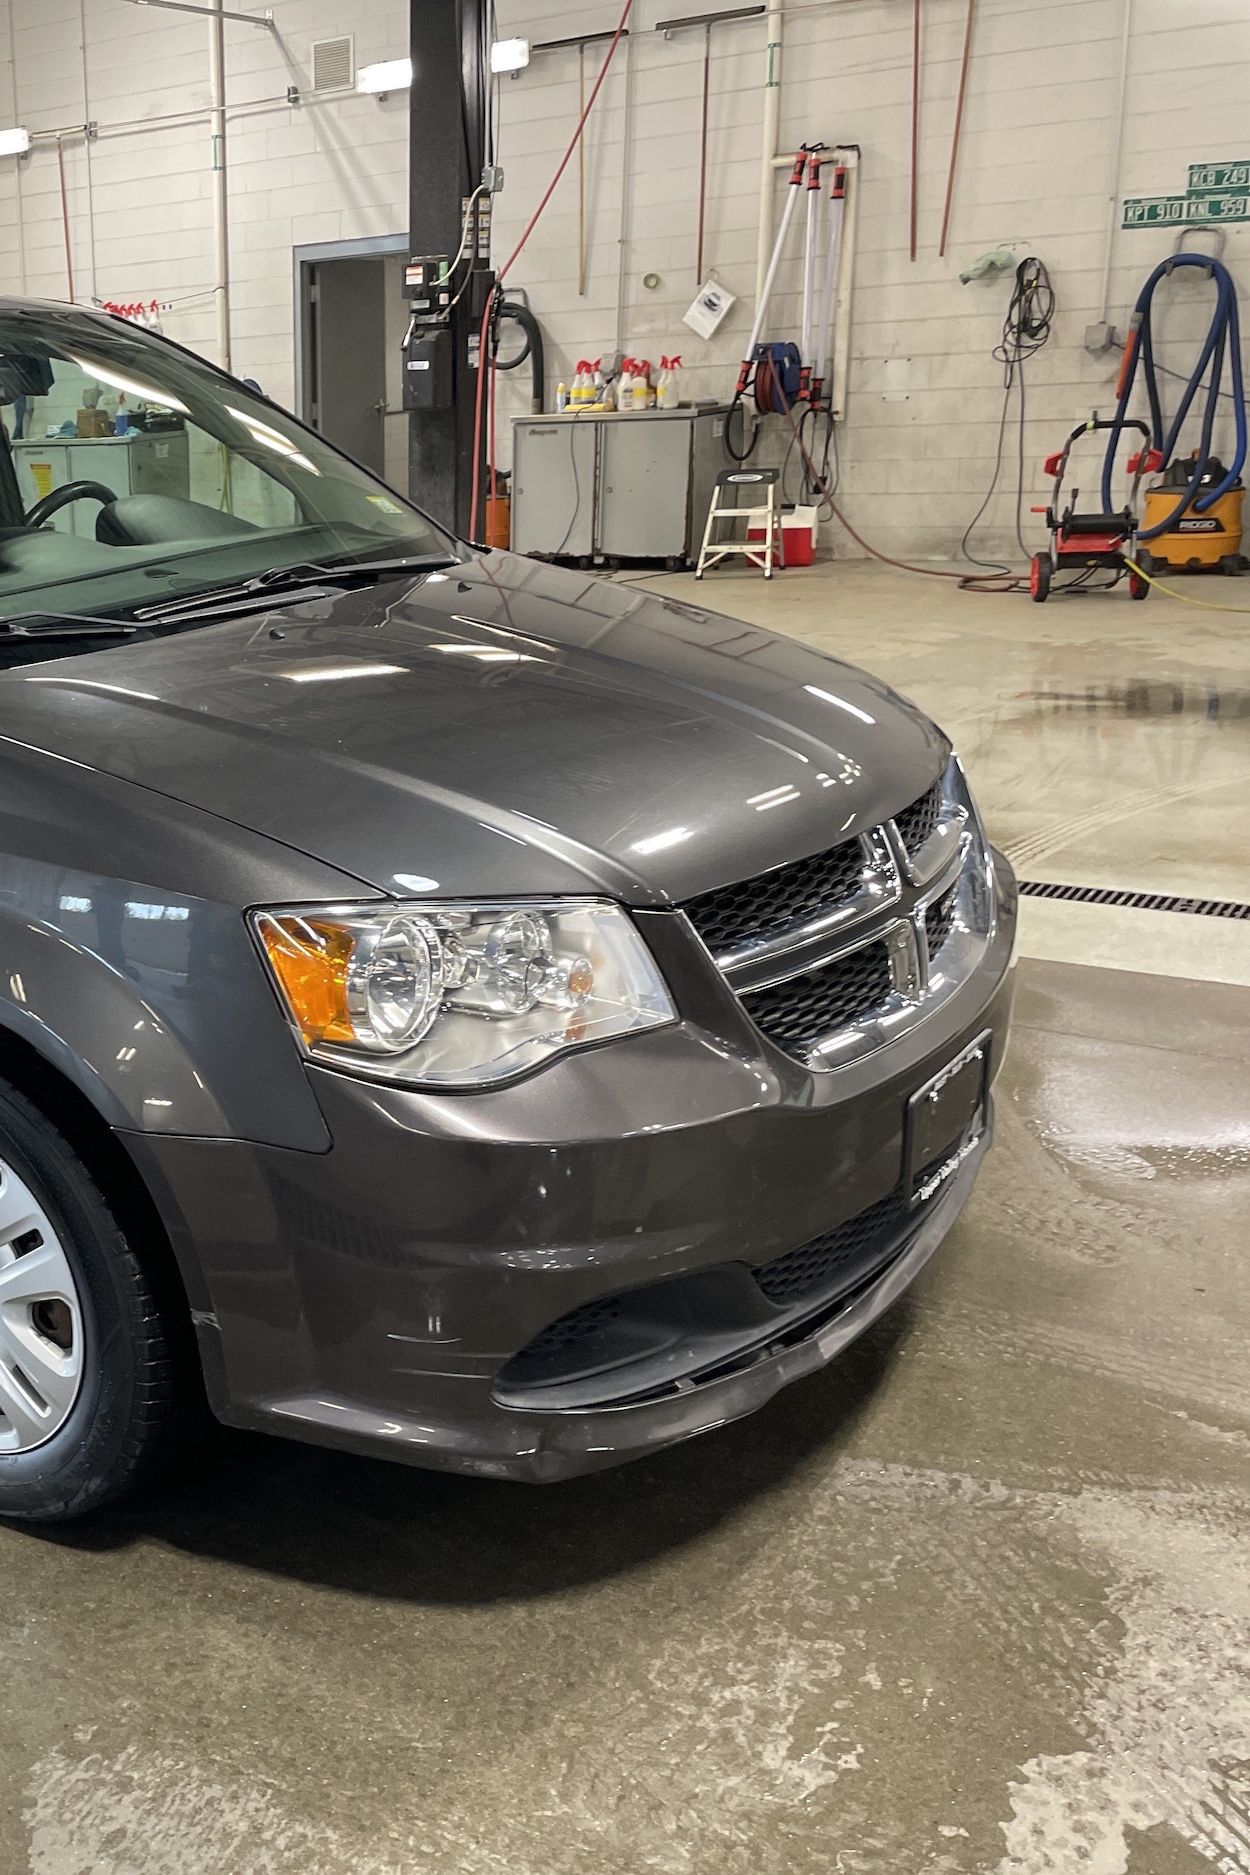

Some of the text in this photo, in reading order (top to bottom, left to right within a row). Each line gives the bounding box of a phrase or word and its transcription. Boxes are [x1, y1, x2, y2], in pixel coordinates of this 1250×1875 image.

[1221, 168, 1247, 186] 249
[1127, 203, 1181, 222] KPT 910
